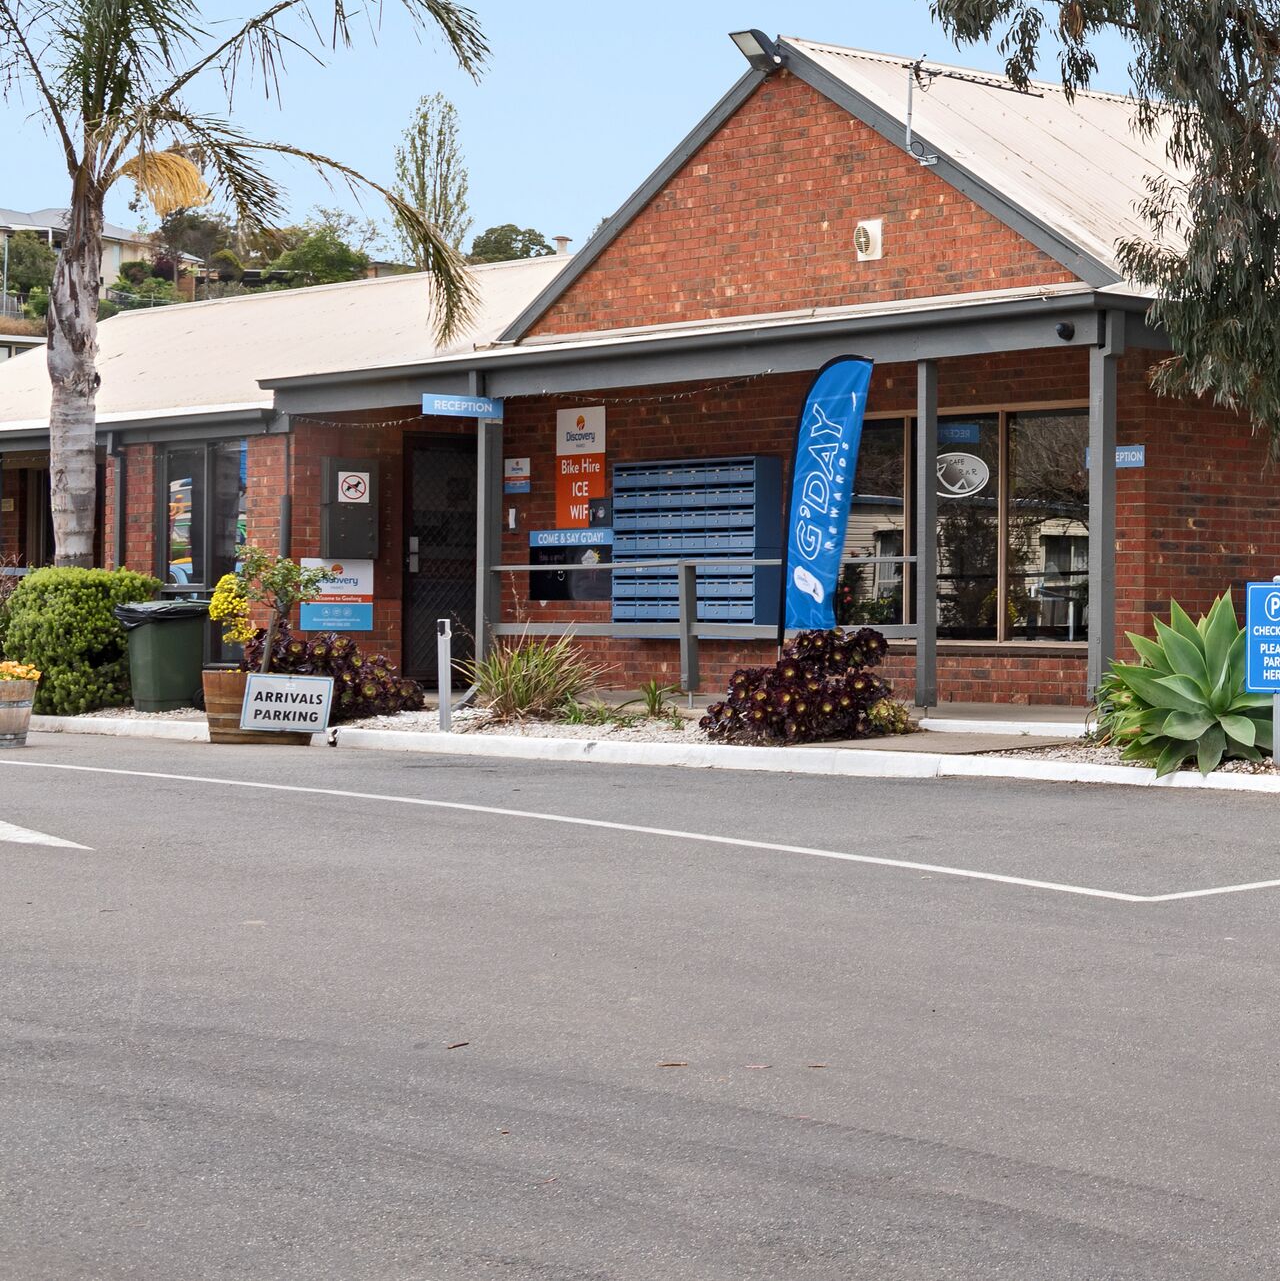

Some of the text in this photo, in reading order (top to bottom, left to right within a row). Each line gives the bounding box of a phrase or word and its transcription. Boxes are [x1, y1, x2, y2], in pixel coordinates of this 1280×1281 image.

[433, 399, 493, 413] RECEPTION
[566, 431, 596, 443] Discovery
[949, 458, 965, 466] CAFE
[1115, 450, 1144, 463] EPTION
[561, 459, 601, 475] Bike Hire
[572, 481, 589, 496] ICE
[795, 403, 843, 561] G'DAY
[823, 441, 850, 551] REWARDS
[569, 504, 589, 519] WIF
[538, 532, 604, 544] COME & SAY G'DAY!
[1270, 597, 1280, 616] P
[253, 691, 323, 705] ARRIVALS
[253, 709, 319, 723] PARKING
